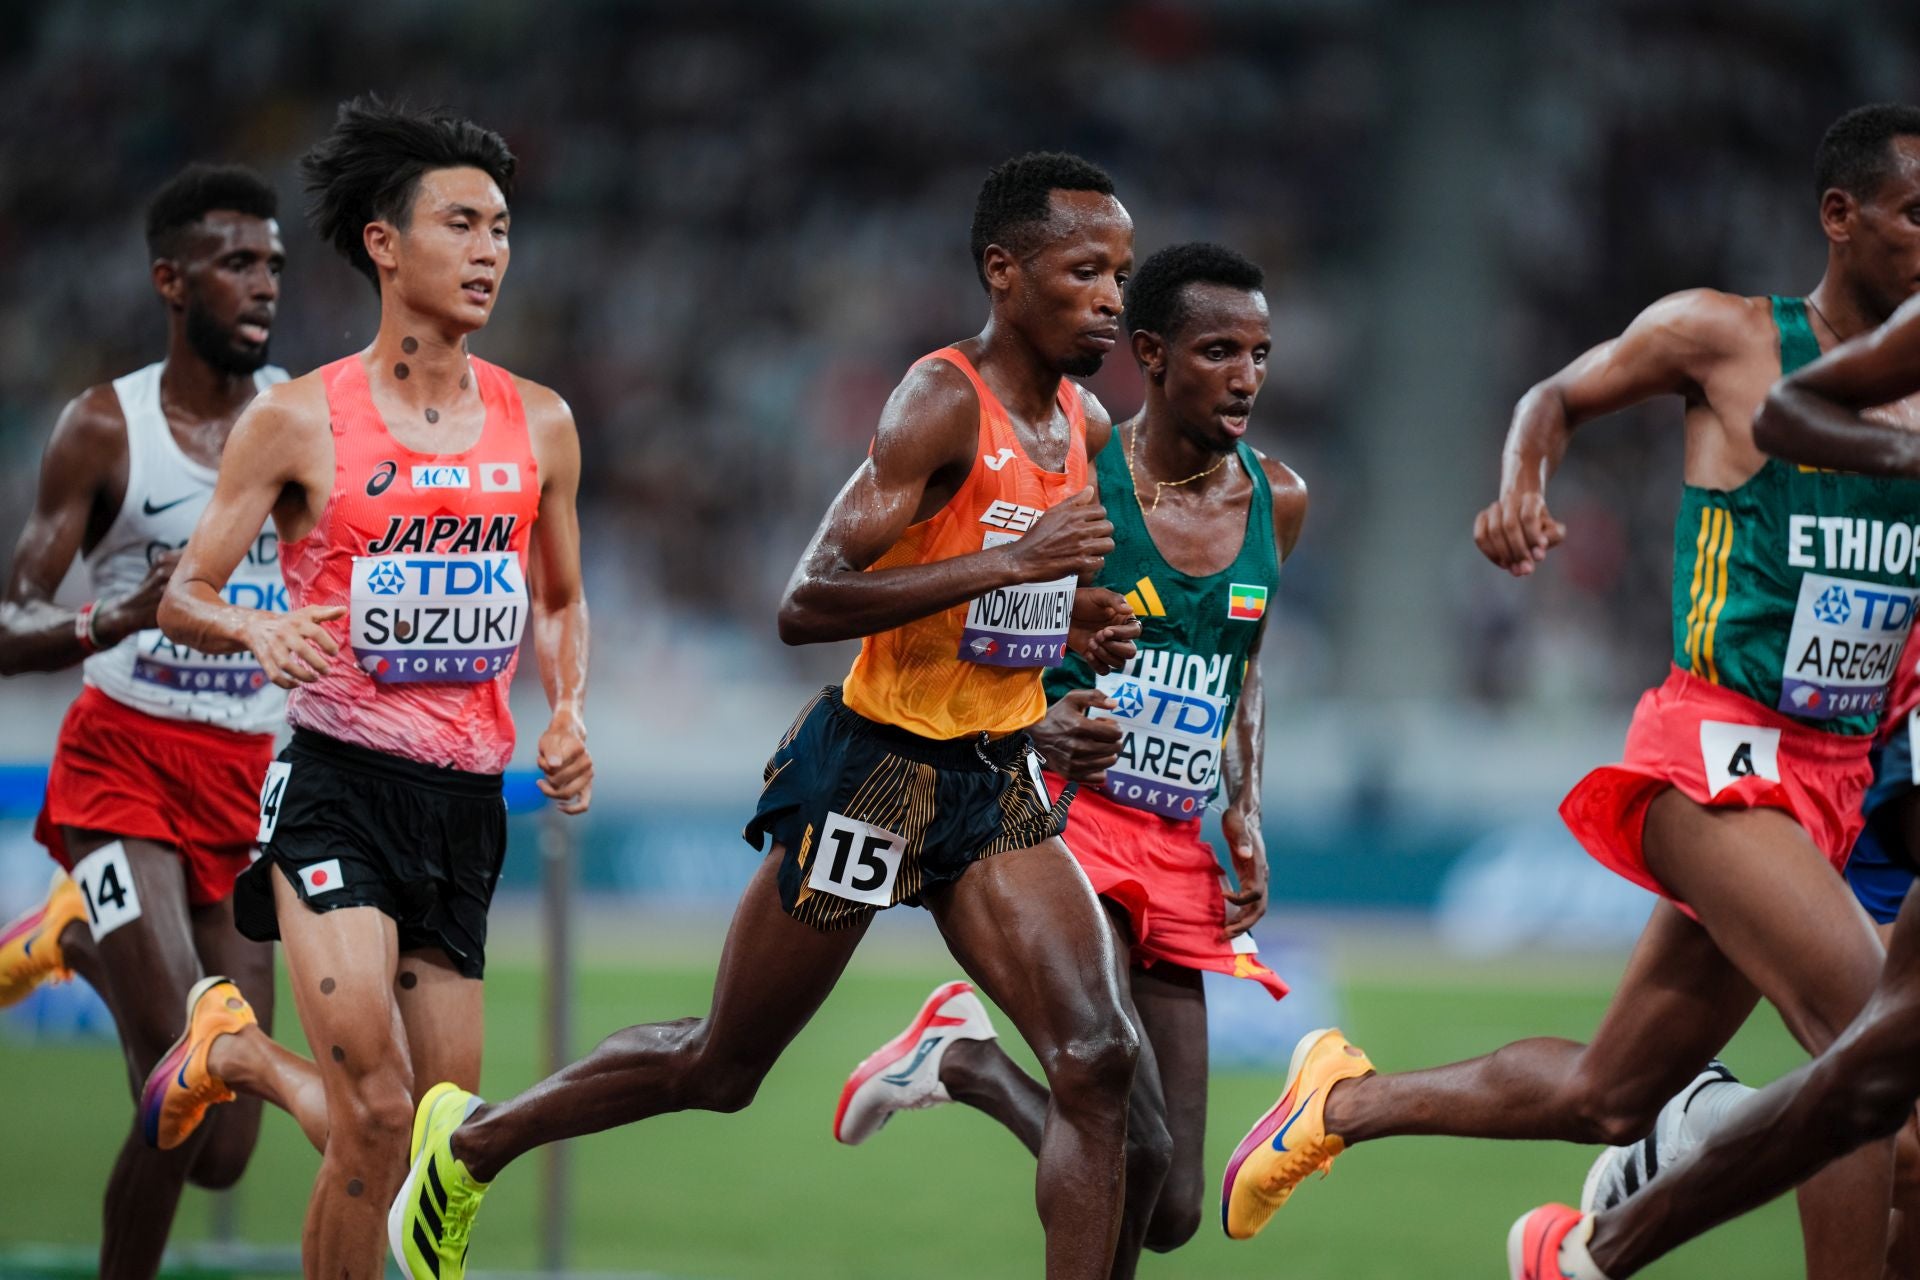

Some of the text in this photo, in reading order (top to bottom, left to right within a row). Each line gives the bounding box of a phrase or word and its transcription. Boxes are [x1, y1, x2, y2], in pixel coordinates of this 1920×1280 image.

[415, 467, 465, 487] ACN
[367, 516, 517, 554] JAPAN
[405, 558, 516, 596] TDK
[363, 605, 518, 645] SUZUKI
[829, 828, 893, 892] 15
[81, 862, 127, 925] 14
